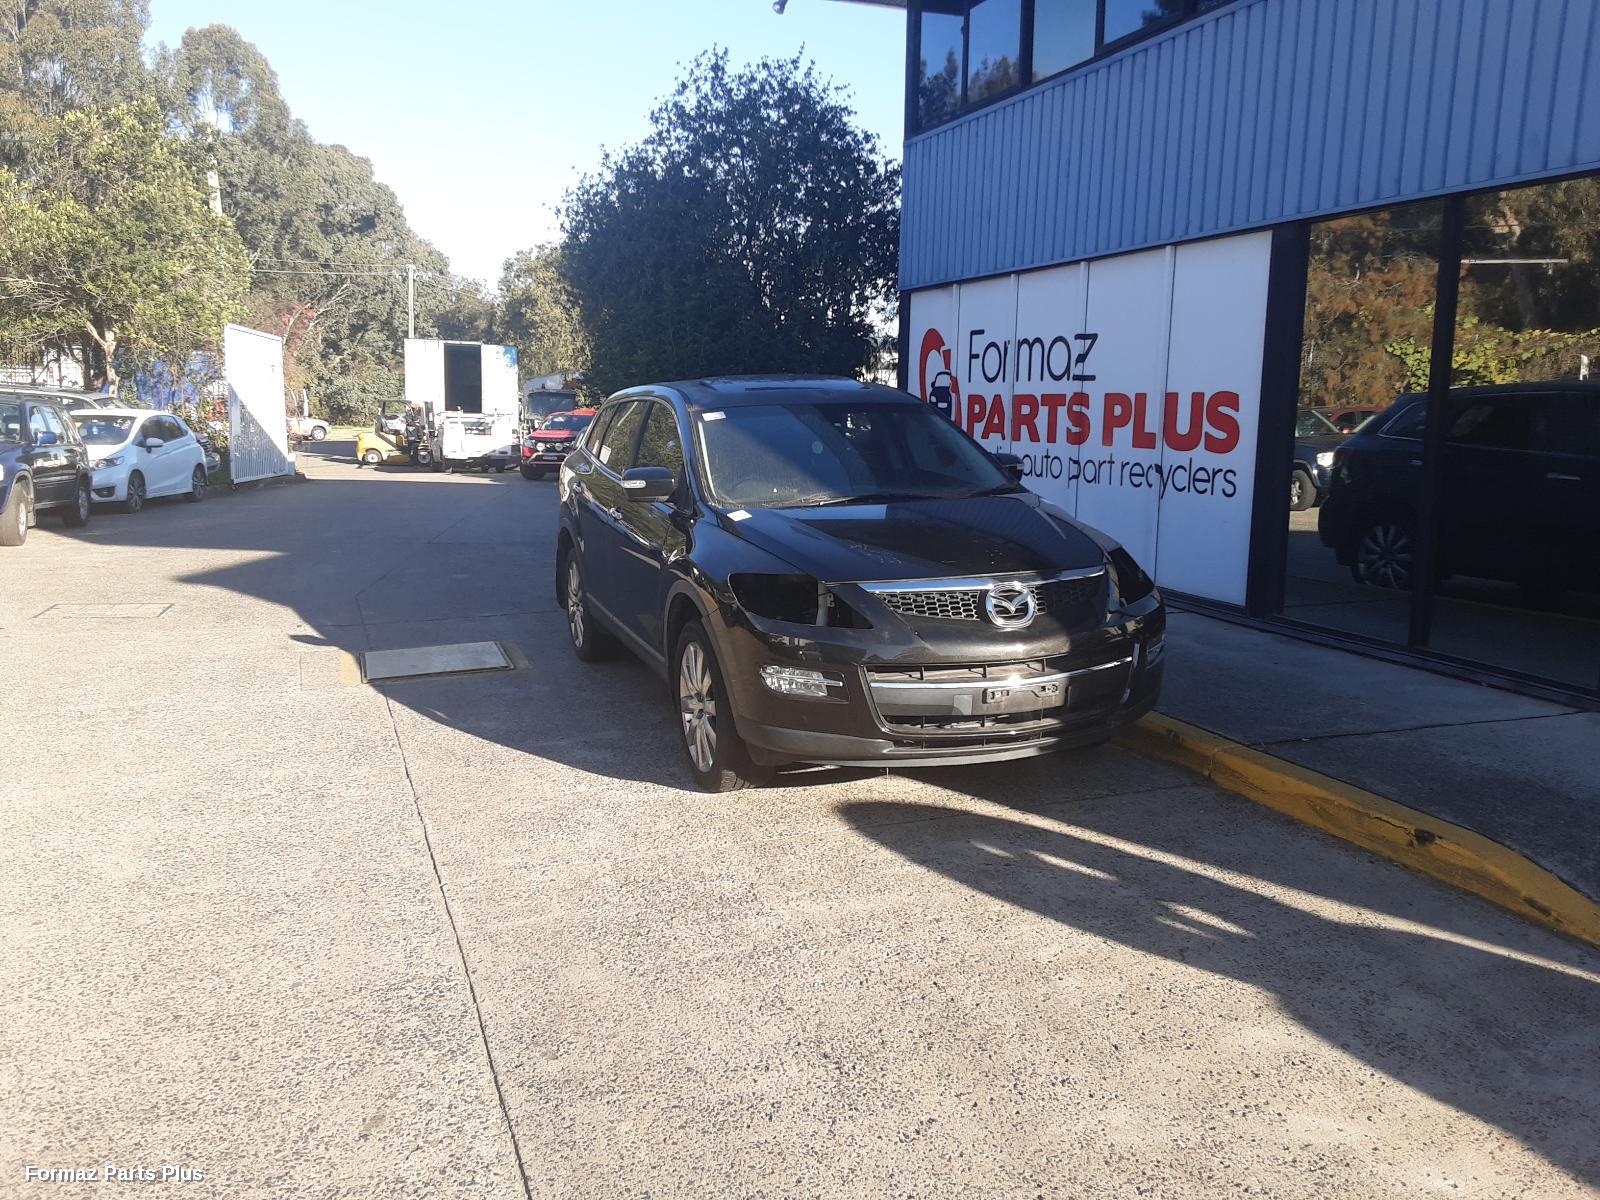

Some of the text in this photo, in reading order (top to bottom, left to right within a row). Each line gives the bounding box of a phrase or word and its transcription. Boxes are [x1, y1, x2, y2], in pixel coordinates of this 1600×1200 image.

[968, 329, 1098, 382] Formaz
[966, 391, 1240, 454] PARTS PLUS
[1021, 448, 1237, 498] auto part recyclers
